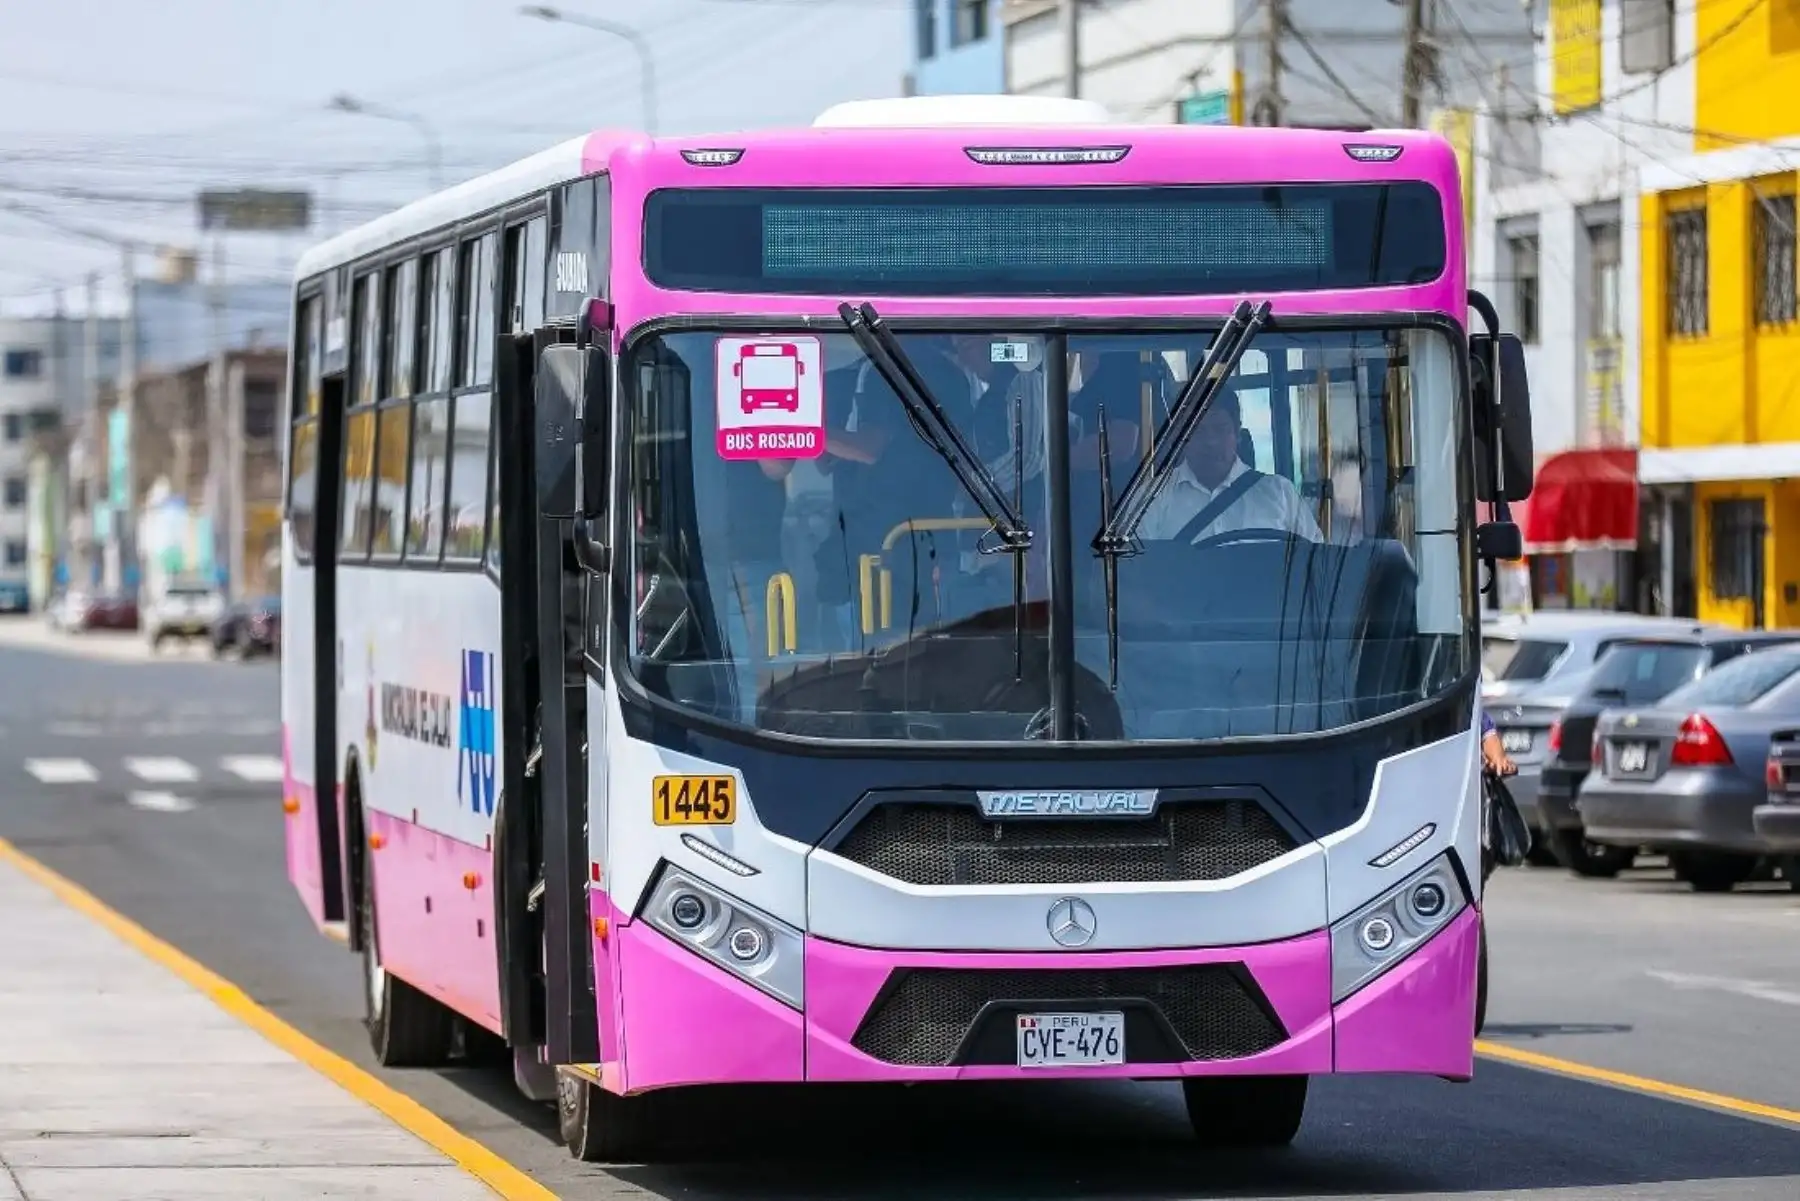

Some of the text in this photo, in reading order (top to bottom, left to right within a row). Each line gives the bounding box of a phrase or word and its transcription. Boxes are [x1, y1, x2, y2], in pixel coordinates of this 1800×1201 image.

[557, 252, 588, 293] SUBIDA
[726, 432, 815, 450] BUS ROSADO
[659, 779, 730, 820] 1445
[986, 792, 1151, 812] METALVAL
[1053, 1016, 1089, 1028] PERU
[1023, 1027, 1119, 1058] CYE-476
